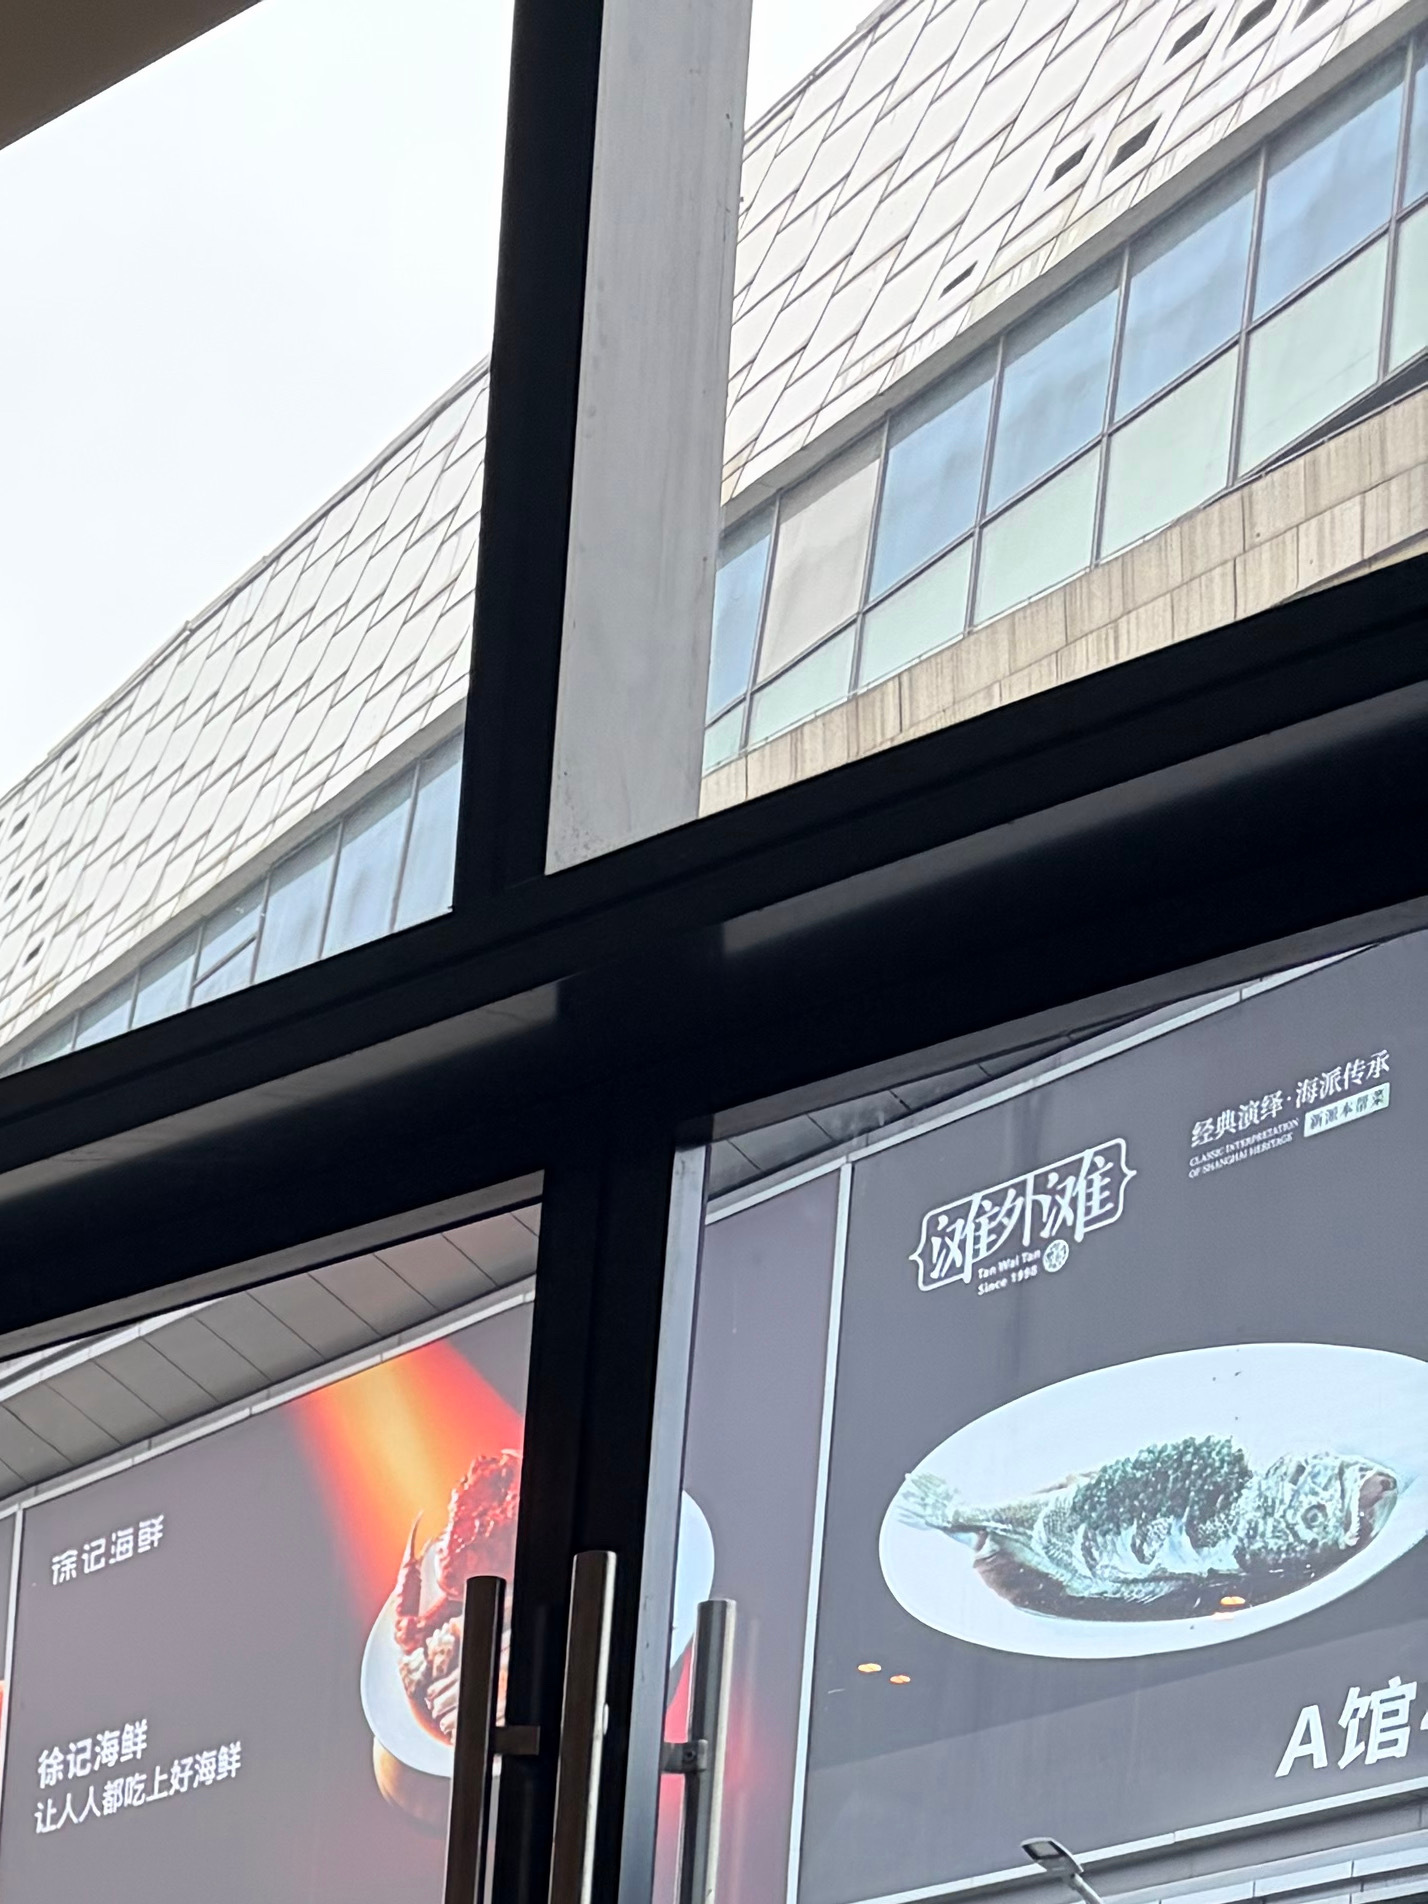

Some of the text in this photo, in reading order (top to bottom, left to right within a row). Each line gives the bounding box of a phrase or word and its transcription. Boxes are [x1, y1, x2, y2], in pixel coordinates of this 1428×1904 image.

[1201, 1149, 1248, 1174] SHANGHAI
[1248, 1132, 1294, 1157] HERITAGE
[1225, 1118, 1299, 1153] INTERPRETATION
[930, 1149, 1115, 1283] 滩外滩
[977, 1277, 1008, 1296] Since
[50, 1514, 166, 1586] 徐记海鲜
[37, 1719, 149, 1789] 徐记海鲜
[1275, 1675, 1428, 1778] A馆
[34, 1741, 242, 1834] 让人人都吃上好海鲜
